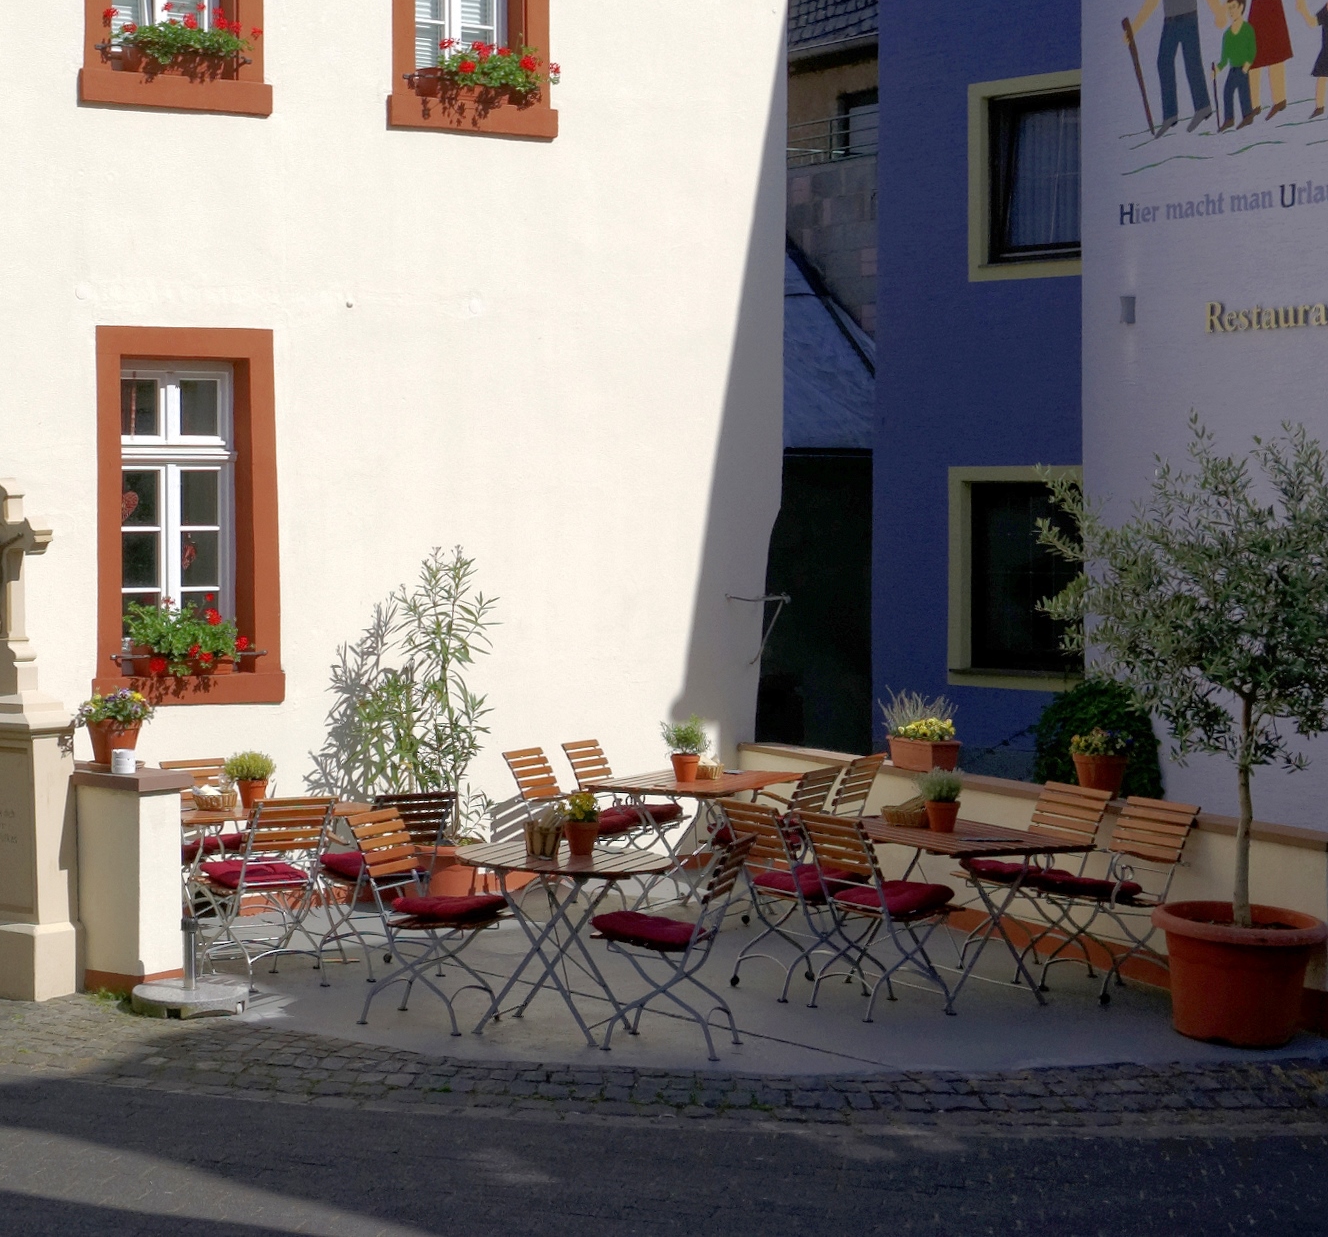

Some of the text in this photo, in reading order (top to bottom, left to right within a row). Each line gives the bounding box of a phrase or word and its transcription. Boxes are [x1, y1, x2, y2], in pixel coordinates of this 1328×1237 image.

[1119, 179, 1328, 225] Hier macht man Urla
[1205, 301, 1328, 333] Restaura
